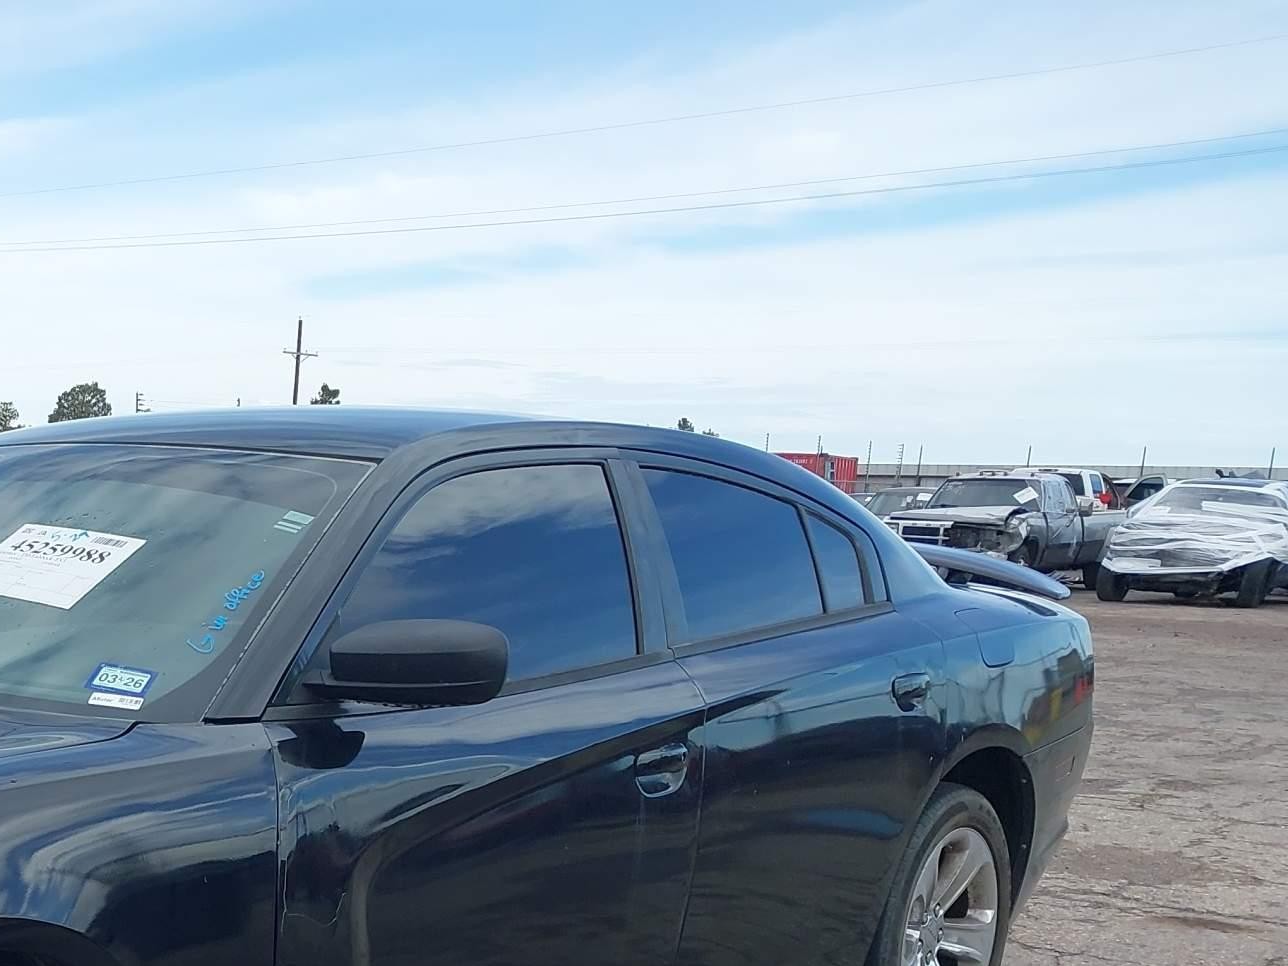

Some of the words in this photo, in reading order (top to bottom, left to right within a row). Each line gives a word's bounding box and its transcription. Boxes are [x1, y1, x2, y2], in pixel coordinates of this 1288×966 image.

[10, 539, 112, 564] 45259988
[98, 672, 119, 684] 03
[123, 677, 145, 689] 26
